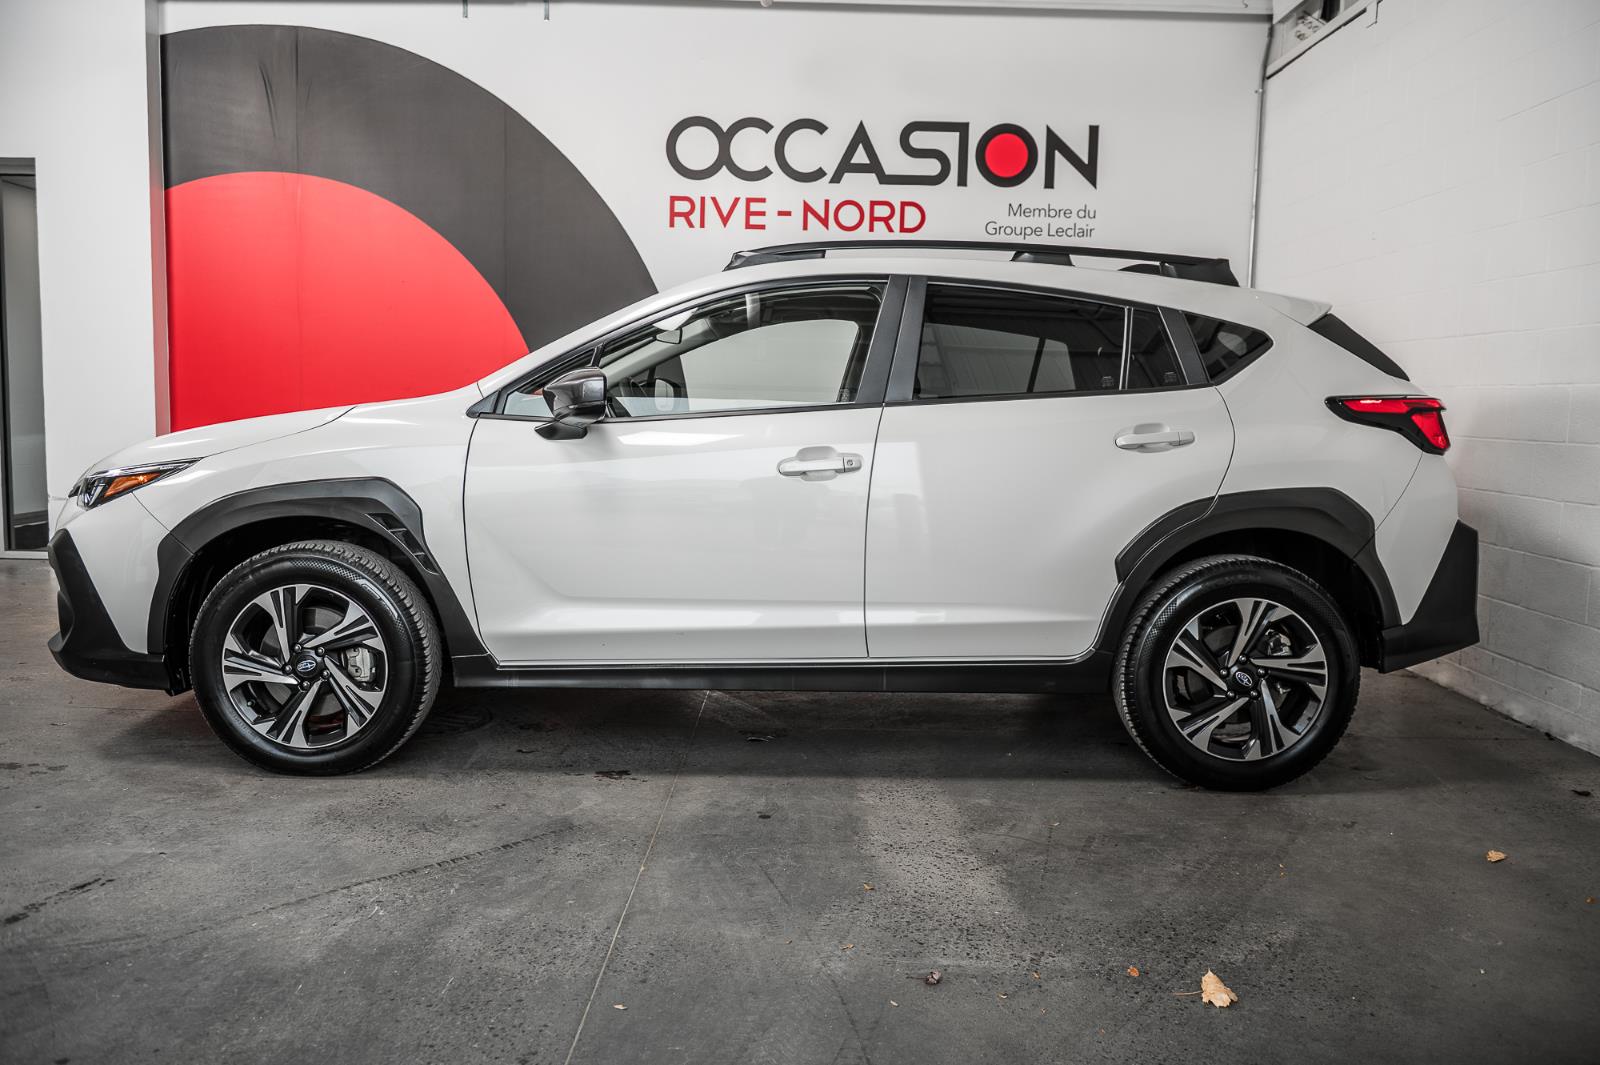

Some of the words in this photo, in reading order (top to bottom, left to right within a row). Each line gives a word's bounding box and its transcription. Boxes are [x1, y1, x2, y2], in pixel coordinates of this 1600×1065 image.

[665, 115, 1100, 190] OCCASION
[1007, 202, 1073, 219] Membre
[1076, 203, 1097, 219] du
[984, 220, 1043, 240] Groupe
[1047, 222, 1095, 238] Leclair
